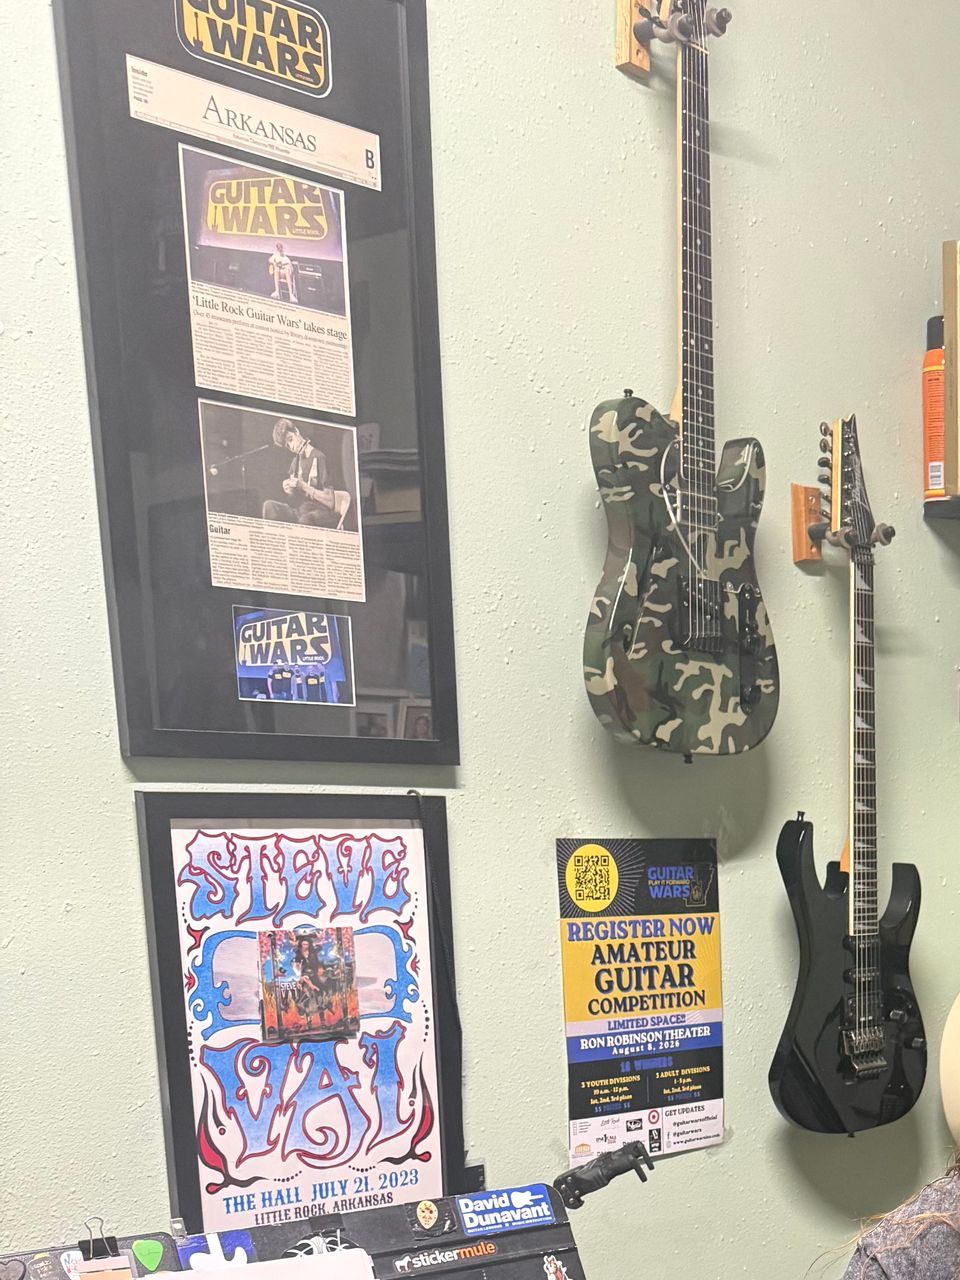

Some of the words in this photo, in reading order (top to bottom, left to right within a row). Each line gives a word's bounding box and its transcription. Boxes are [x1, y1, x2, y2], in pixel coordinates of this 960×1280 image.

[182, 0, 321, 51] GUITAR
[206, 17, 322, 85] WARS
[202, 95, 317, 152] ARKANSAS
[365, 148, 375, 169] B
[210, 179, 321, 205] GUITAR
[221, 205, 325, 237] WARS
[221, 300, 245, 316] Rock
[246, 307, 275, 323] Guitar
[303, 321, 325, 336] takes
[326, 328, 348, 341] stage
[208, 523, 231, 536] Guitar
[241, 613, 328, 643] GUITAR
[249, 636, 329, 664] WARS
[178, 829, 411, 927] STEVE
[648, 866, 694, 880] GUITAR
[650, 885, 690, 898] WARS
[567, 919, 665, 942] REGISTER
[669, 916, 715, 937] NOW
[590, 940, 697, 966] AMATEUR
[594, 963, 696, 995] GUITAR
[587, 990, 706, 1016] COMPETITION
[607, 1018, 649, 1031] LIMITED
[580, 1037, 606, 1050] RON
[606, 1030, 664, 1047] ROBINSON
[664, 1026, 711, 1039] THEATER
[611, 1044, 645, 1055] August
[659, 1040, 680, 1049] 2026
[586, 1077, 609, 1087] YOUTH
[609, 1075, 641, 1085] DIVISIONS
[660, 1069, 680, 1079] ADULT
[681, 1066, 711, 1076] DIVISIONS
[200, 1021, 416, 1170] VAI
[665, 1109, 680, 1117] GET
[680, 1105, 705, 1116] UPDATES
[223, 1195, 256, 1215] THE
[260, 1189, 303, 1212] HALL
[310, 1180, 348, 1204] JULY
[378, 1168, 419, 1192] 2023
[459, 1192, 510, 1213] David
[255, 1205, 292, 1225] LITTLE
[333, 1192, 394, 1214] ARKANSAS
[463, 1201, 551, 1229] Dunavant
[411, 1240, 496, 1269] stickermule
